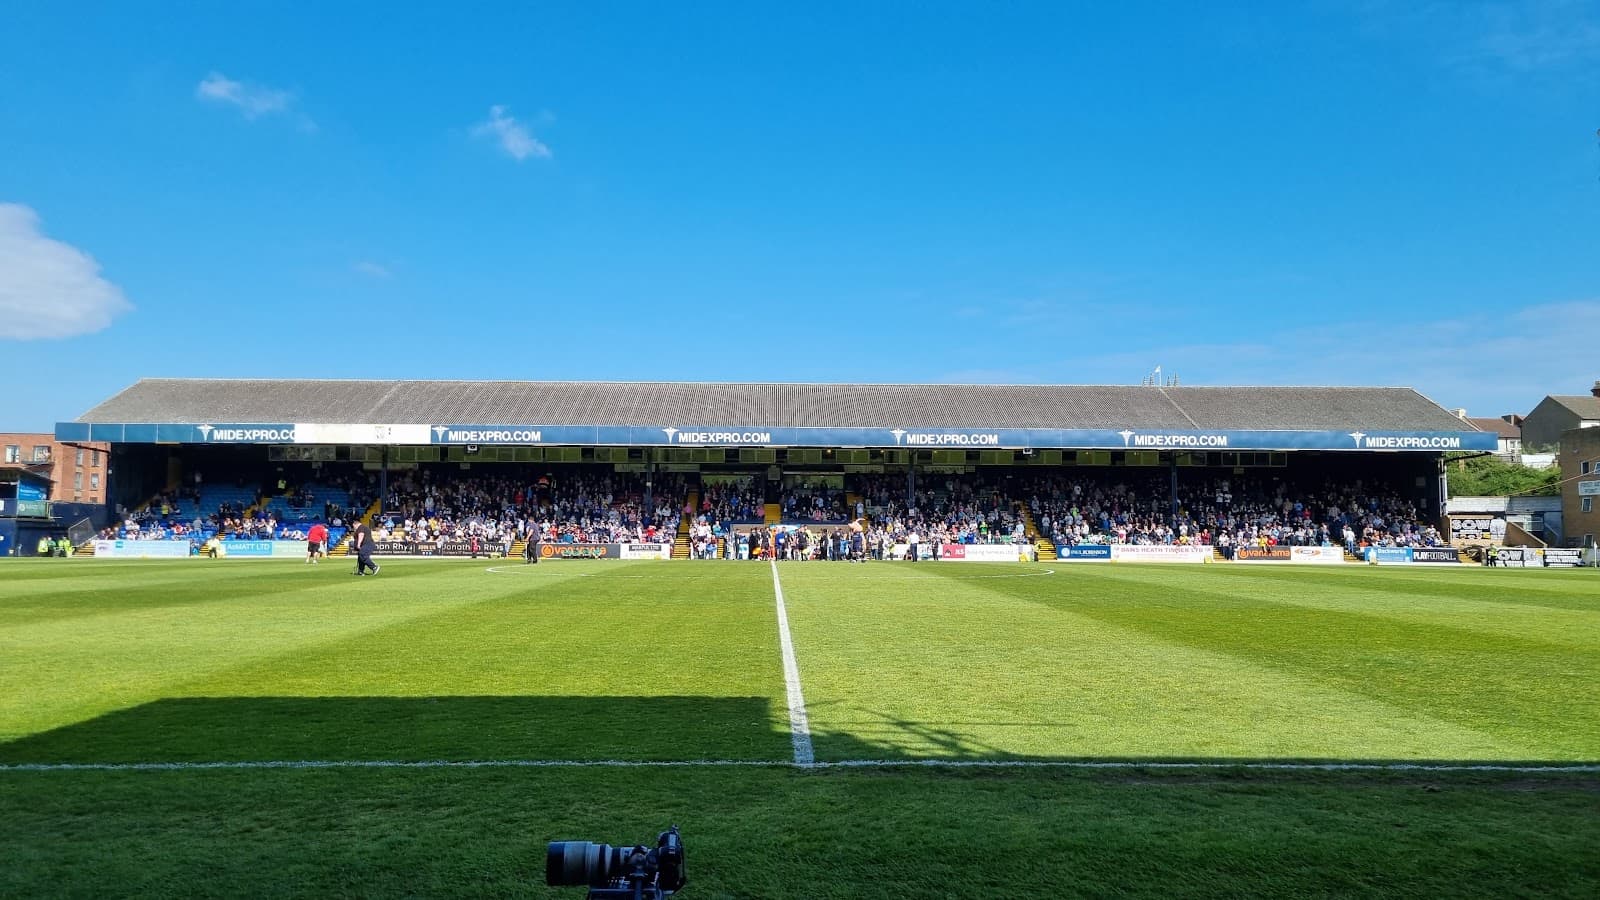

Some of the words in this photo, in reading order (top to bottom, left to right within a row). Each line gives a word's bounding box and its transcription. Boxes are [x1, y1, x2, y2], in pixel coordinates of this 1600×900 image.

[448, 431, 541, 441] MIDEXPRO.COM
[678, 432, 771, 443] MIDEXPRO.COM
[906, 434, 998, 444] MIDEXPRO.COM
[1134, 435, 1228, 446] MIDEXPRO.COM
[1365, 437, 1460, 448] MIDEXPRO.COM
[442, 543, 481, 551] Jonathn
[484, 543, 504, 552] Rhys
